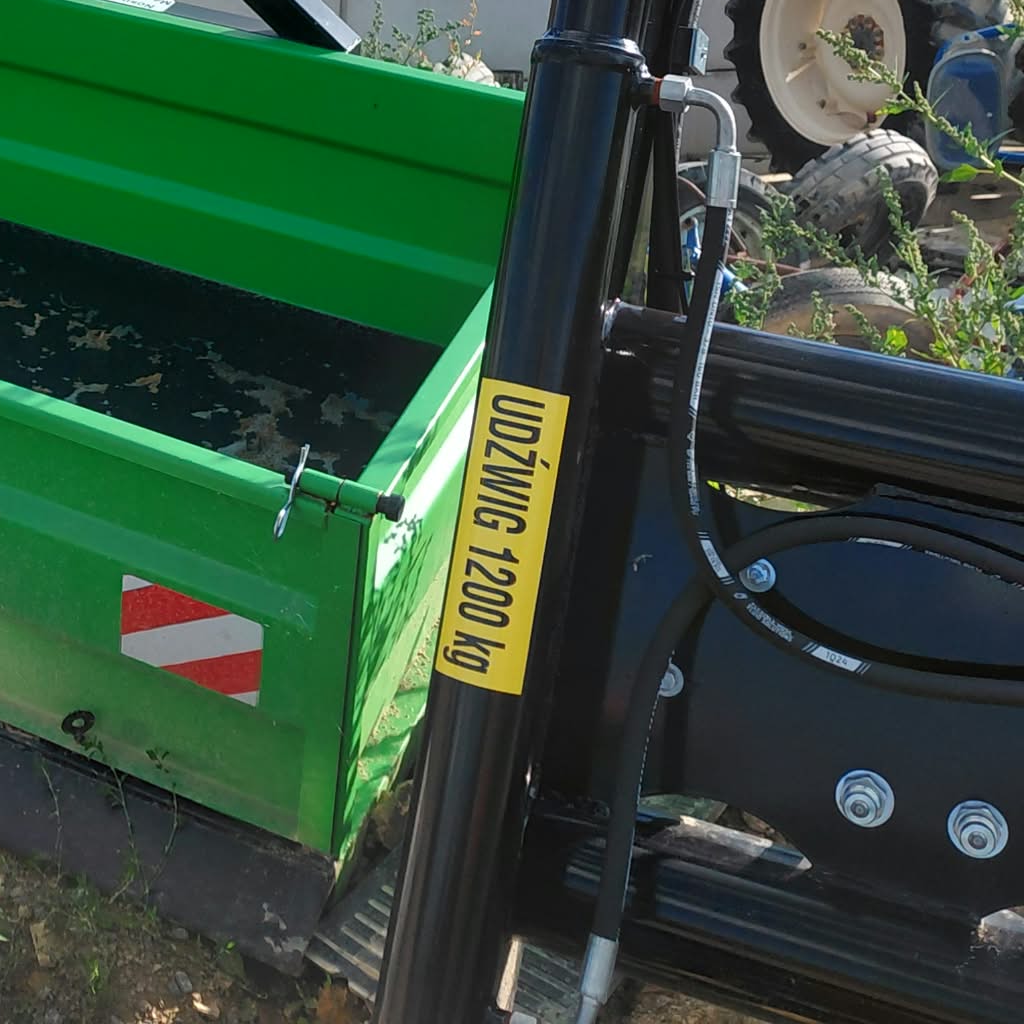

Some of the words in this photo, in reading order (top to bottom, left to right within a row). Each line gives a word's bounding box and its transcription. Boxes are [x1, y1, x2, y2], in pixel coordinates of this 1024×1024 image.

[472, 394, 550, 535] UDŹWIG
[458, 545, 520, 629] 1200
[443, 630, 506, 674] kg
